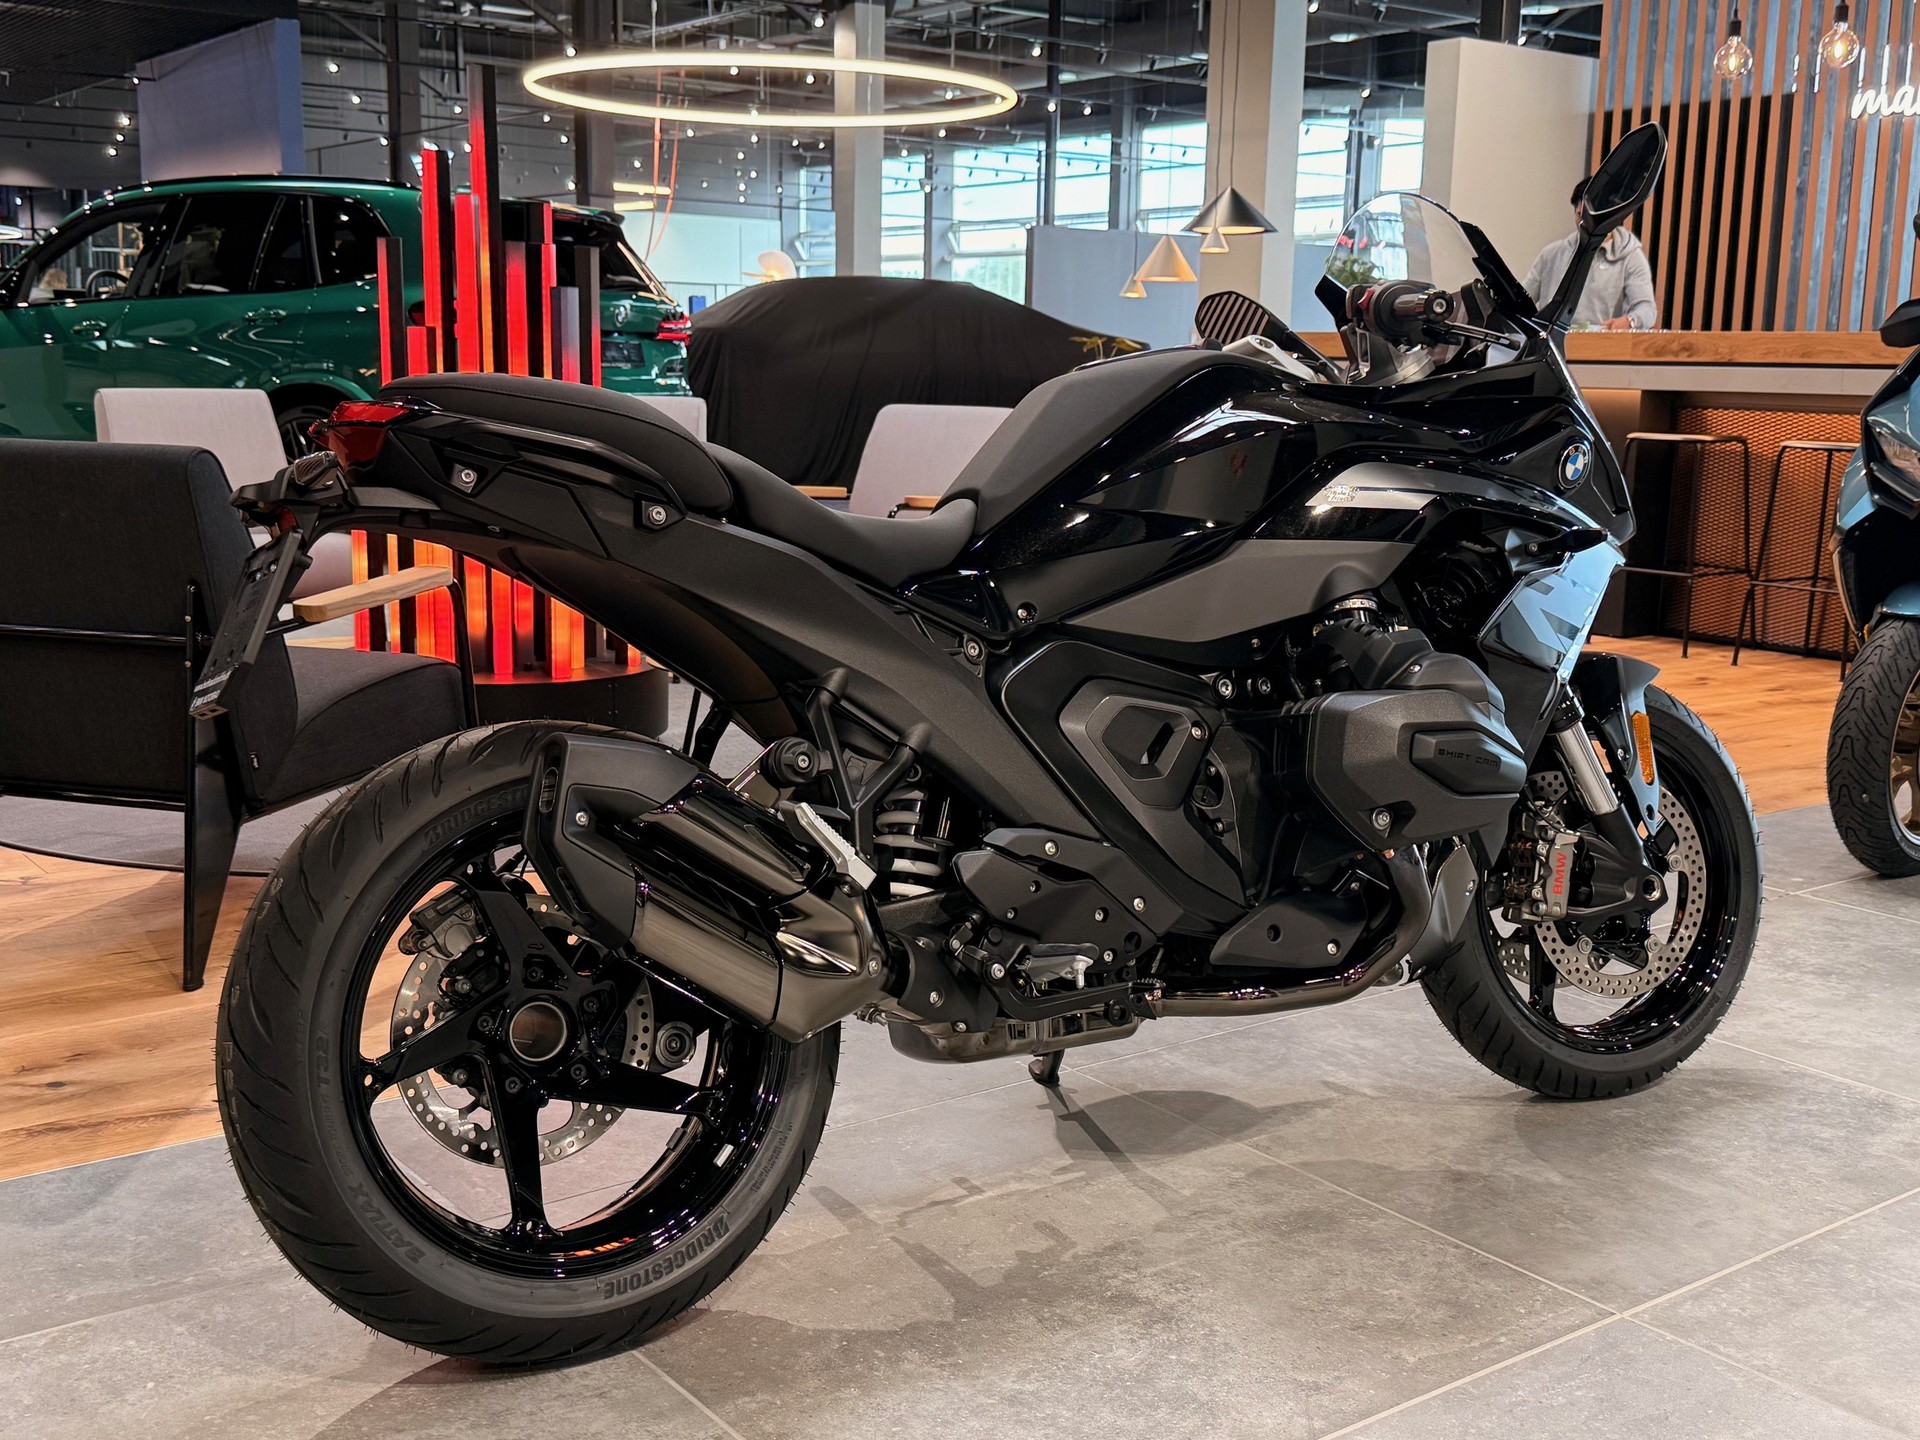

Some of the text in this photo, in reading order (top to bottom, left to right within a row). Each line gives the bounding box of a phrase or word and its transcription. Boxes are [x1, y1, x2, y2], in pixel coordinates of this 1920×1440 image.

[1438, 748, 1498, 767] SHIFT CAM
[1552, 851, 1567, 896] BMW
[603, 1214, 730, 1300] BRIDGESTONE
